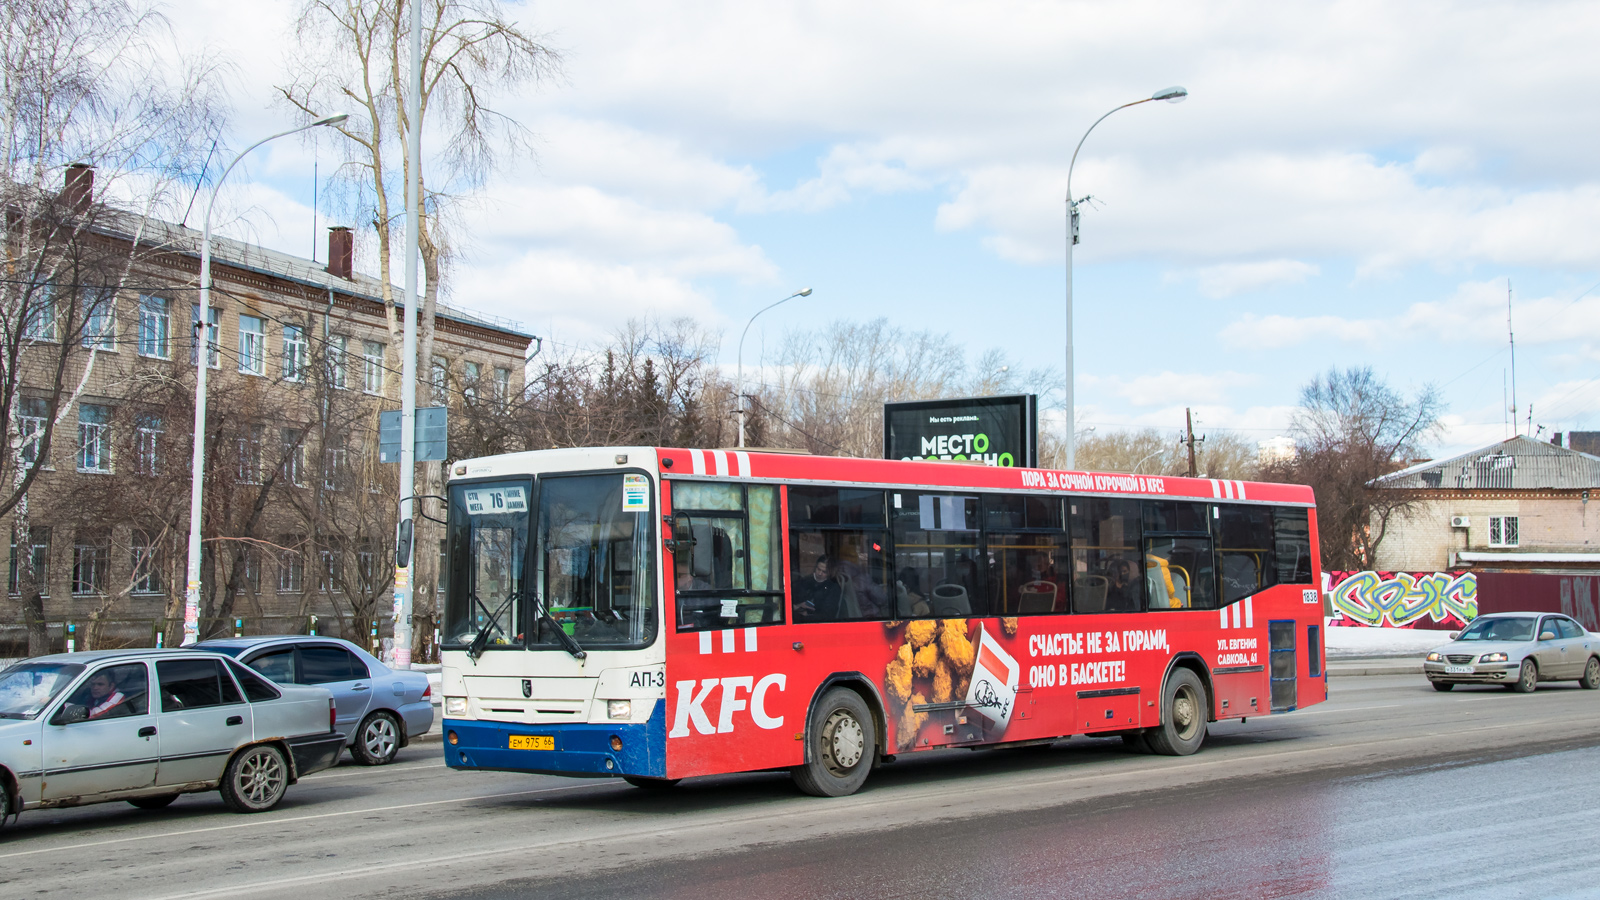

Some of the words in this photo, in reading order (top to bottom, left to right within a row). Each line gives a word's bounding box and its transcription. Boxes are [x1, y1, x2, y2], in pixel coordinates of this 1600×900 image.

[953, 415, 979, 424] реклама.
[921, 433, 989, 455] МЕСТО
[1021, 471, 1046, 487] ПОРА
[1046, 472, 1060, 488] ЗА
[1059, 472, 1094, 490] СОЧНОЙ
[1094, 474, 1139, 493] КУРОЧКОЙ
[1139, 477, 1147, 493] В
[1146, 478, 1165, 493] KFC!
[469, 503, 483, 511] МЕГА
[489, 492, 504, 509] 76
[1303, 591, 1318, 603] 1838
[1029, 632, 1083, 657] СЧАСТЬЕ
[1086, 632, 1102, 654] НЕ
[1105, 631, 1121, 653] ЗА
[1122, 629, 1170, 655] ГОРАМИ,
[1217, 639, 1229, 650] УЛ.
[1229, 638, 1258, 650] ЕВГЕНИЯ
[1217, 653, 1250, 666] САВКОВА,
[1250, 652, 1258, 663] 41
[630, 671, 665, 687] АП-3
[1029, 664, 1056, 688] ОНО
[1059, 664, 1068, 686] В
[1070, 660, 1126, 685] БАСКЕТЕ!
[669, 673, 787, 738] KFC
[1000, 697, 1010, 719] KFC
[525, 737, 540, 748] 975
[543, 737, 552, 746] 66
